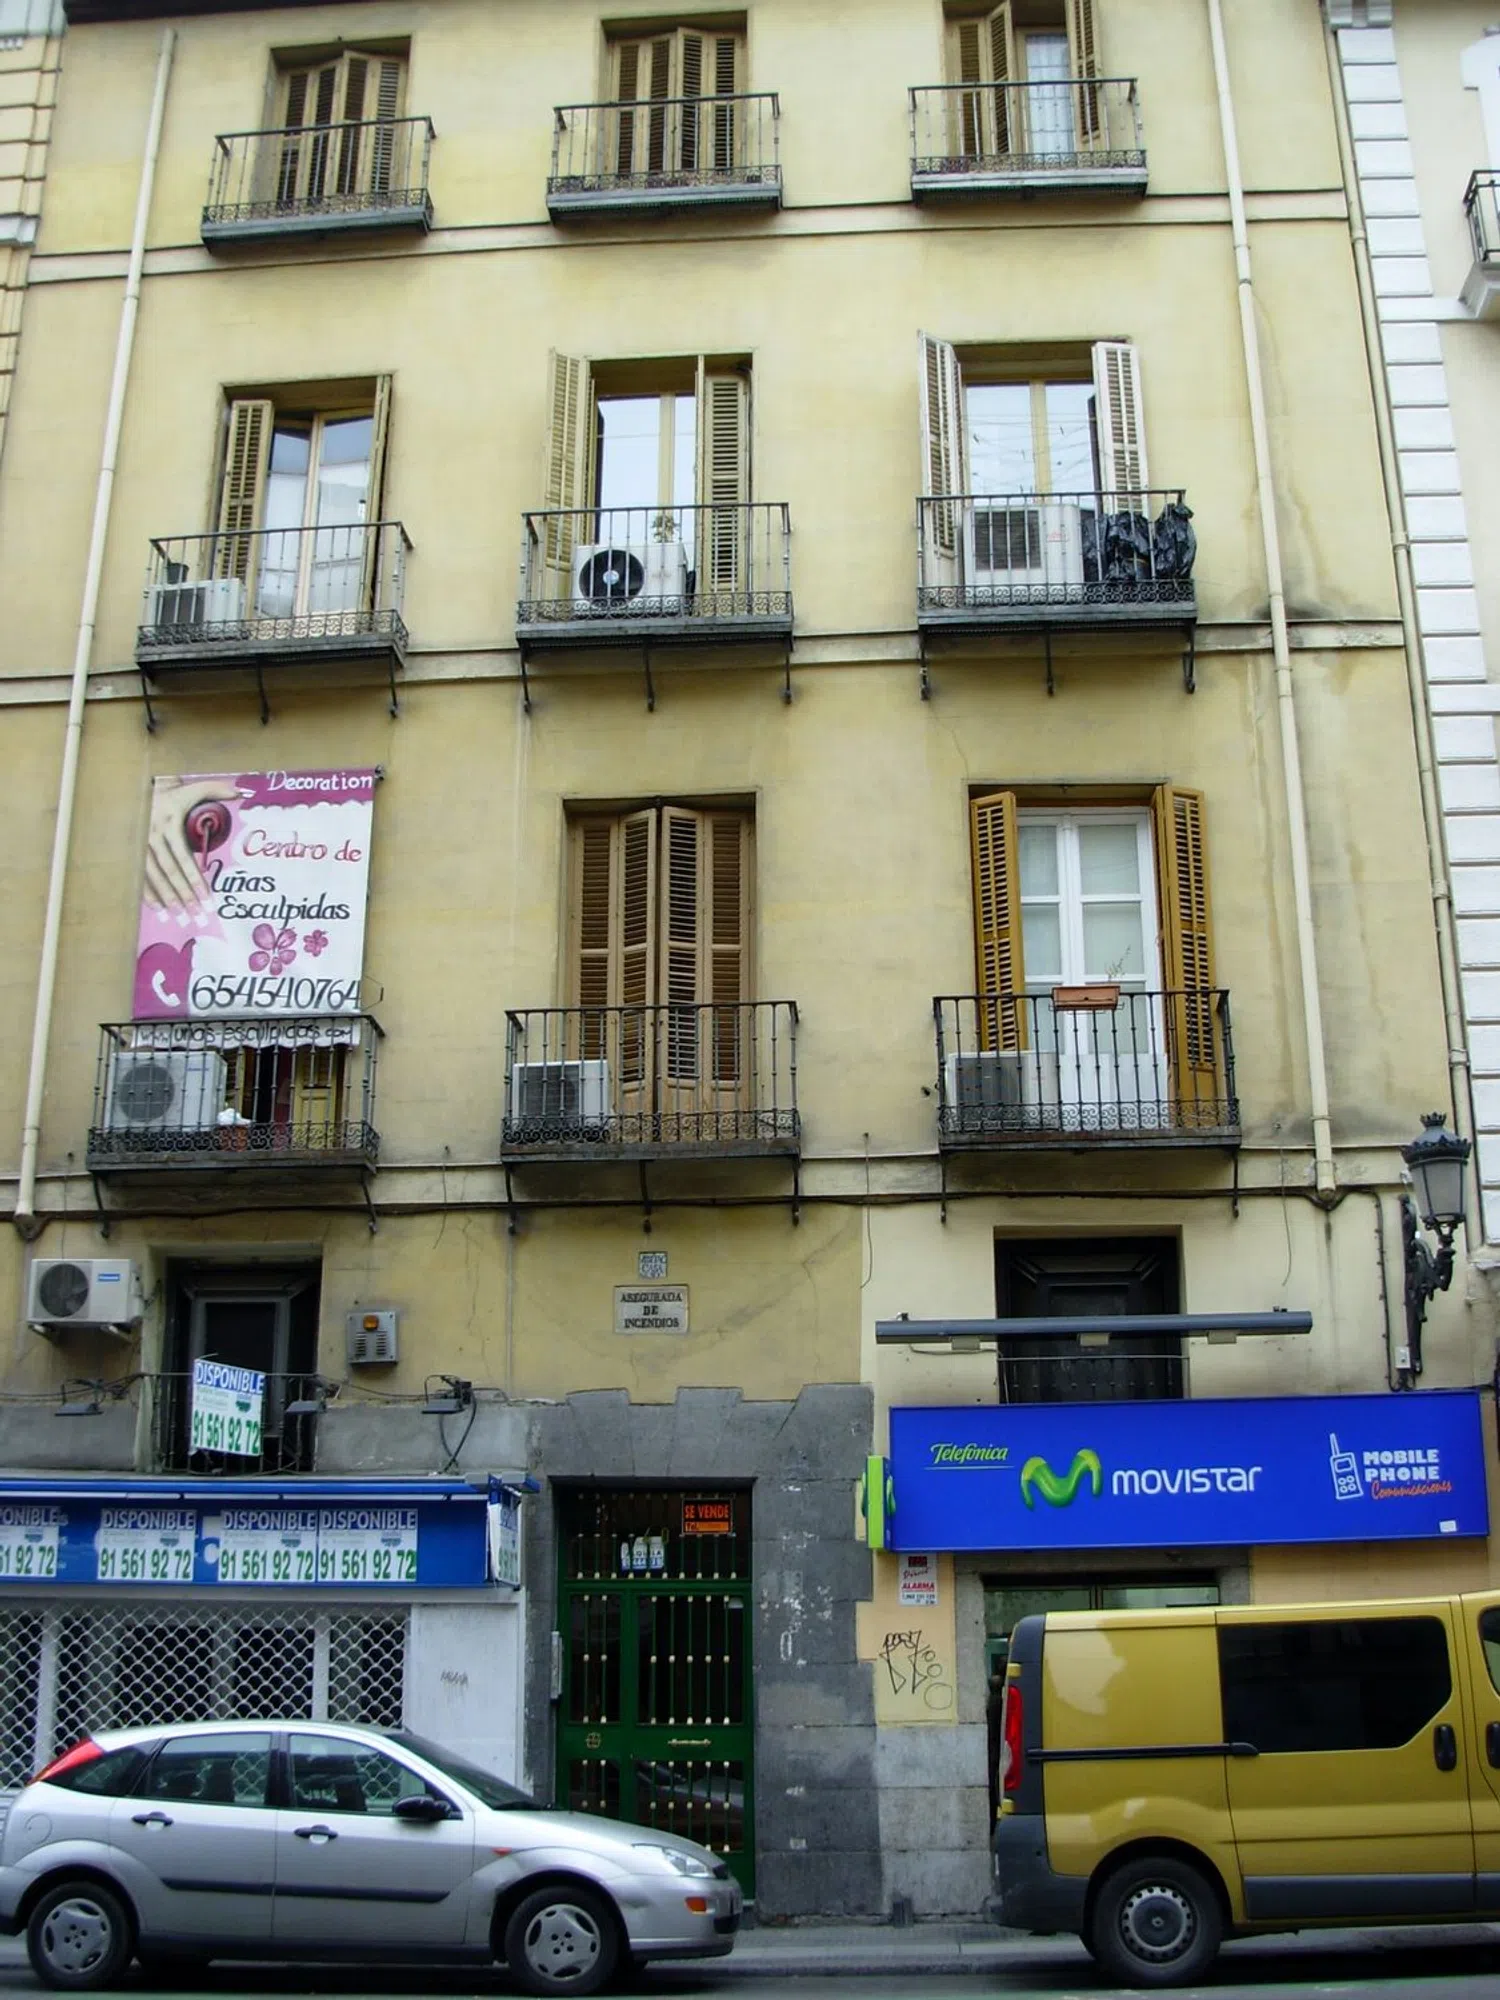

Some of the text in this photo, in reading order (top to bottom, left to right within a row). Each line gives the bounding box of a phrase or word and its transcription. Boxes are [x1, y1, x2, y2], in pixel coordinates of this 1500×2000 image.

[266, 770, 373, 791] Decoration
[242, 830, 363, 862] Centro de
[217, 893, 351, 929] Esculpidas
[620, 1292, 682, 1302] ASEGURADA
[643, 1306, 659, 1316] DE
[624, 1318, 680, 1328] INCENDIOS
[195, 1362, 265, 1394] DISPONIBLE
[193, 1409, 260, 1454] 91 561 92 72
[1363, 1449, 1440, 1466] MOBILE
[1365, 1466, 1440, 1482] PHONE
[103, 1511, 195, 1529] DISPONIBLE
[223, 1512, 315, 1530] DISPONIBLE
[321, 1511, 416, 1529] DISPONIBLE
[685, 1504, 729, 1519] SE VENDE
[15, 1546, 32, 1575] 92
[38, 1546, 55, 1575] 72
[100, 1548, 191, 1579] 91 561 92 72
[221, 1549, 314, 1580] 91 561 92 72
[320, 1550, 416, 1580] 91 561 92 72
